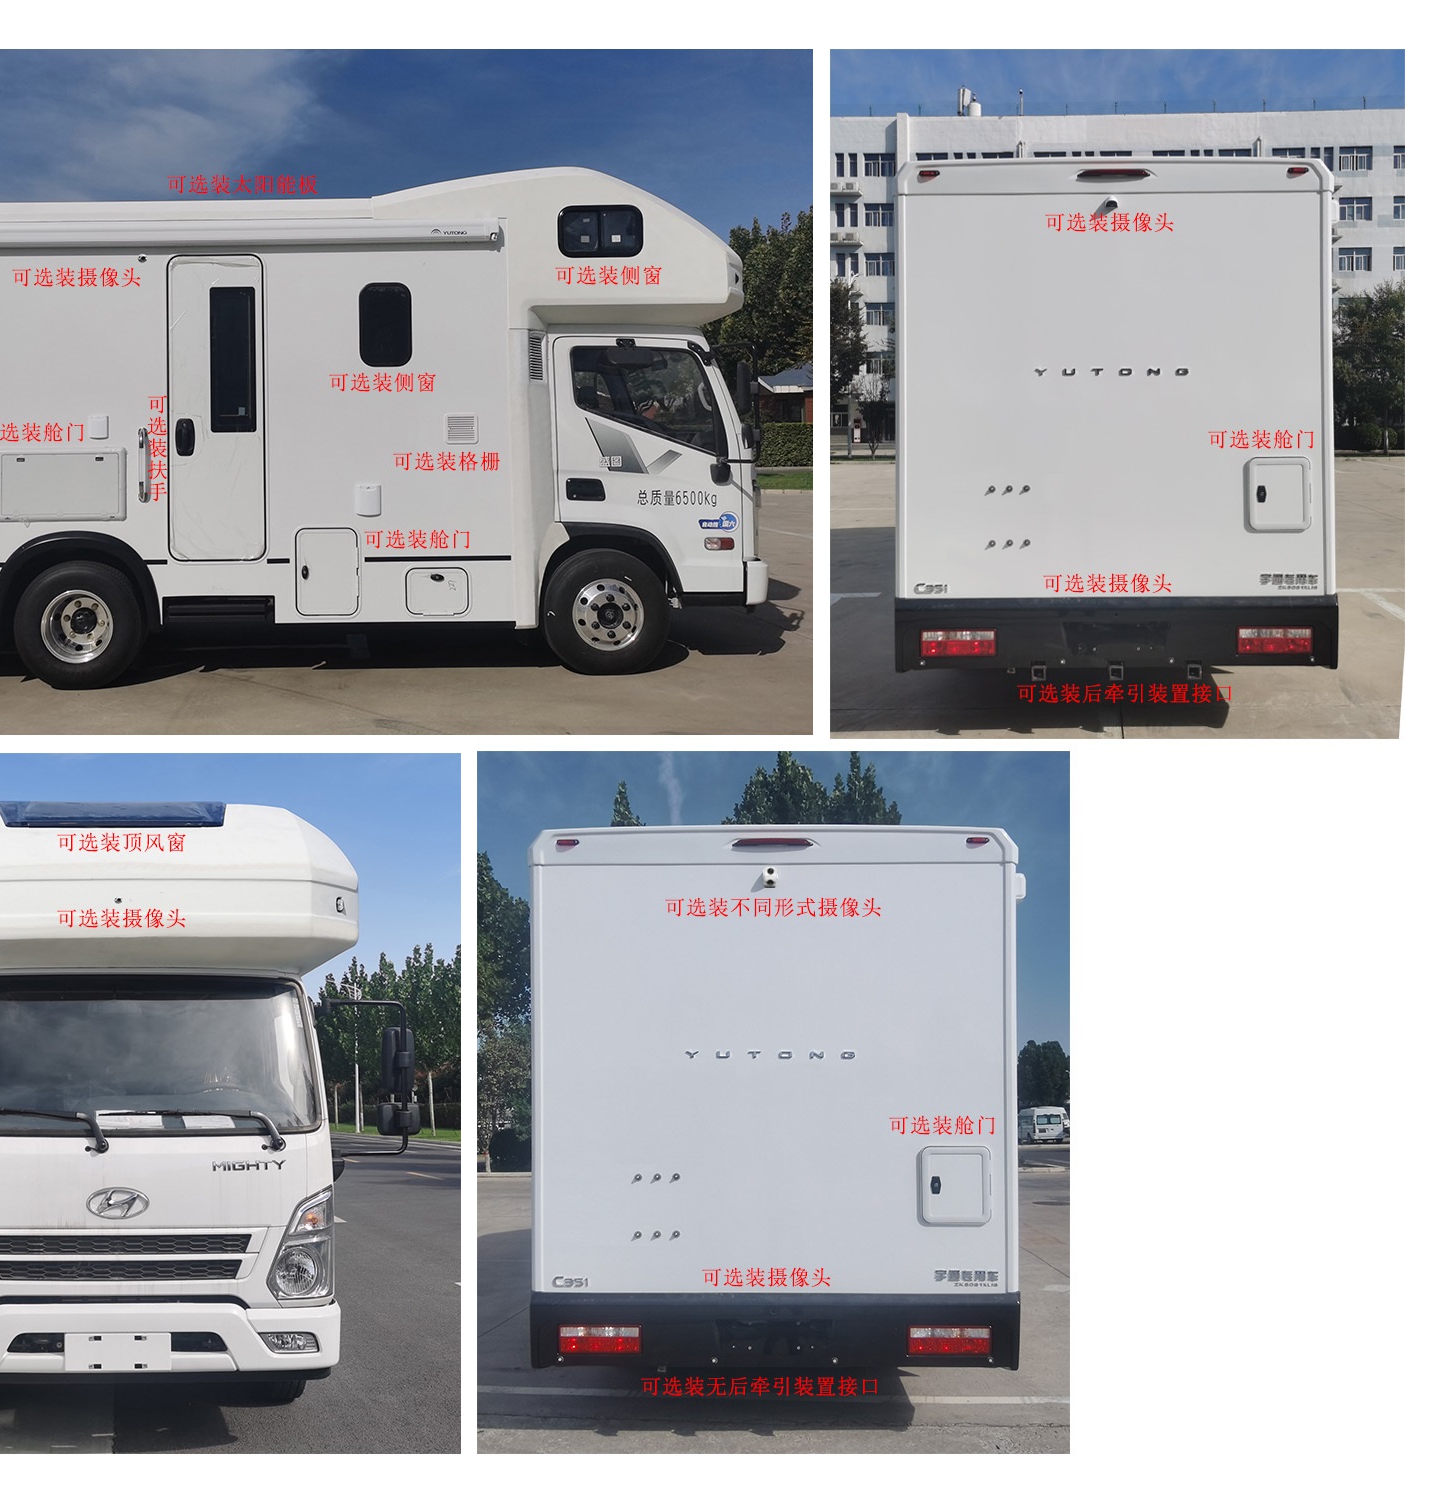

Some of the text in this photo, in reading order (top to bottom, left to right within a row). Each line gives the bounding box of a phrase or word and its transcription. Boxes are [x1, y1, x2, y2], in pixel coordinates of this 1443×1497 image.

[1034, 368, 1189, 377] YUTONG
[637, 489, 717, 507] 总质量6500kg
[685, 1050, 856, 1060] YUTONG
[212, 1160, 286, 1171] MIGHTY
[552, 1276, 589, 1288] C351
